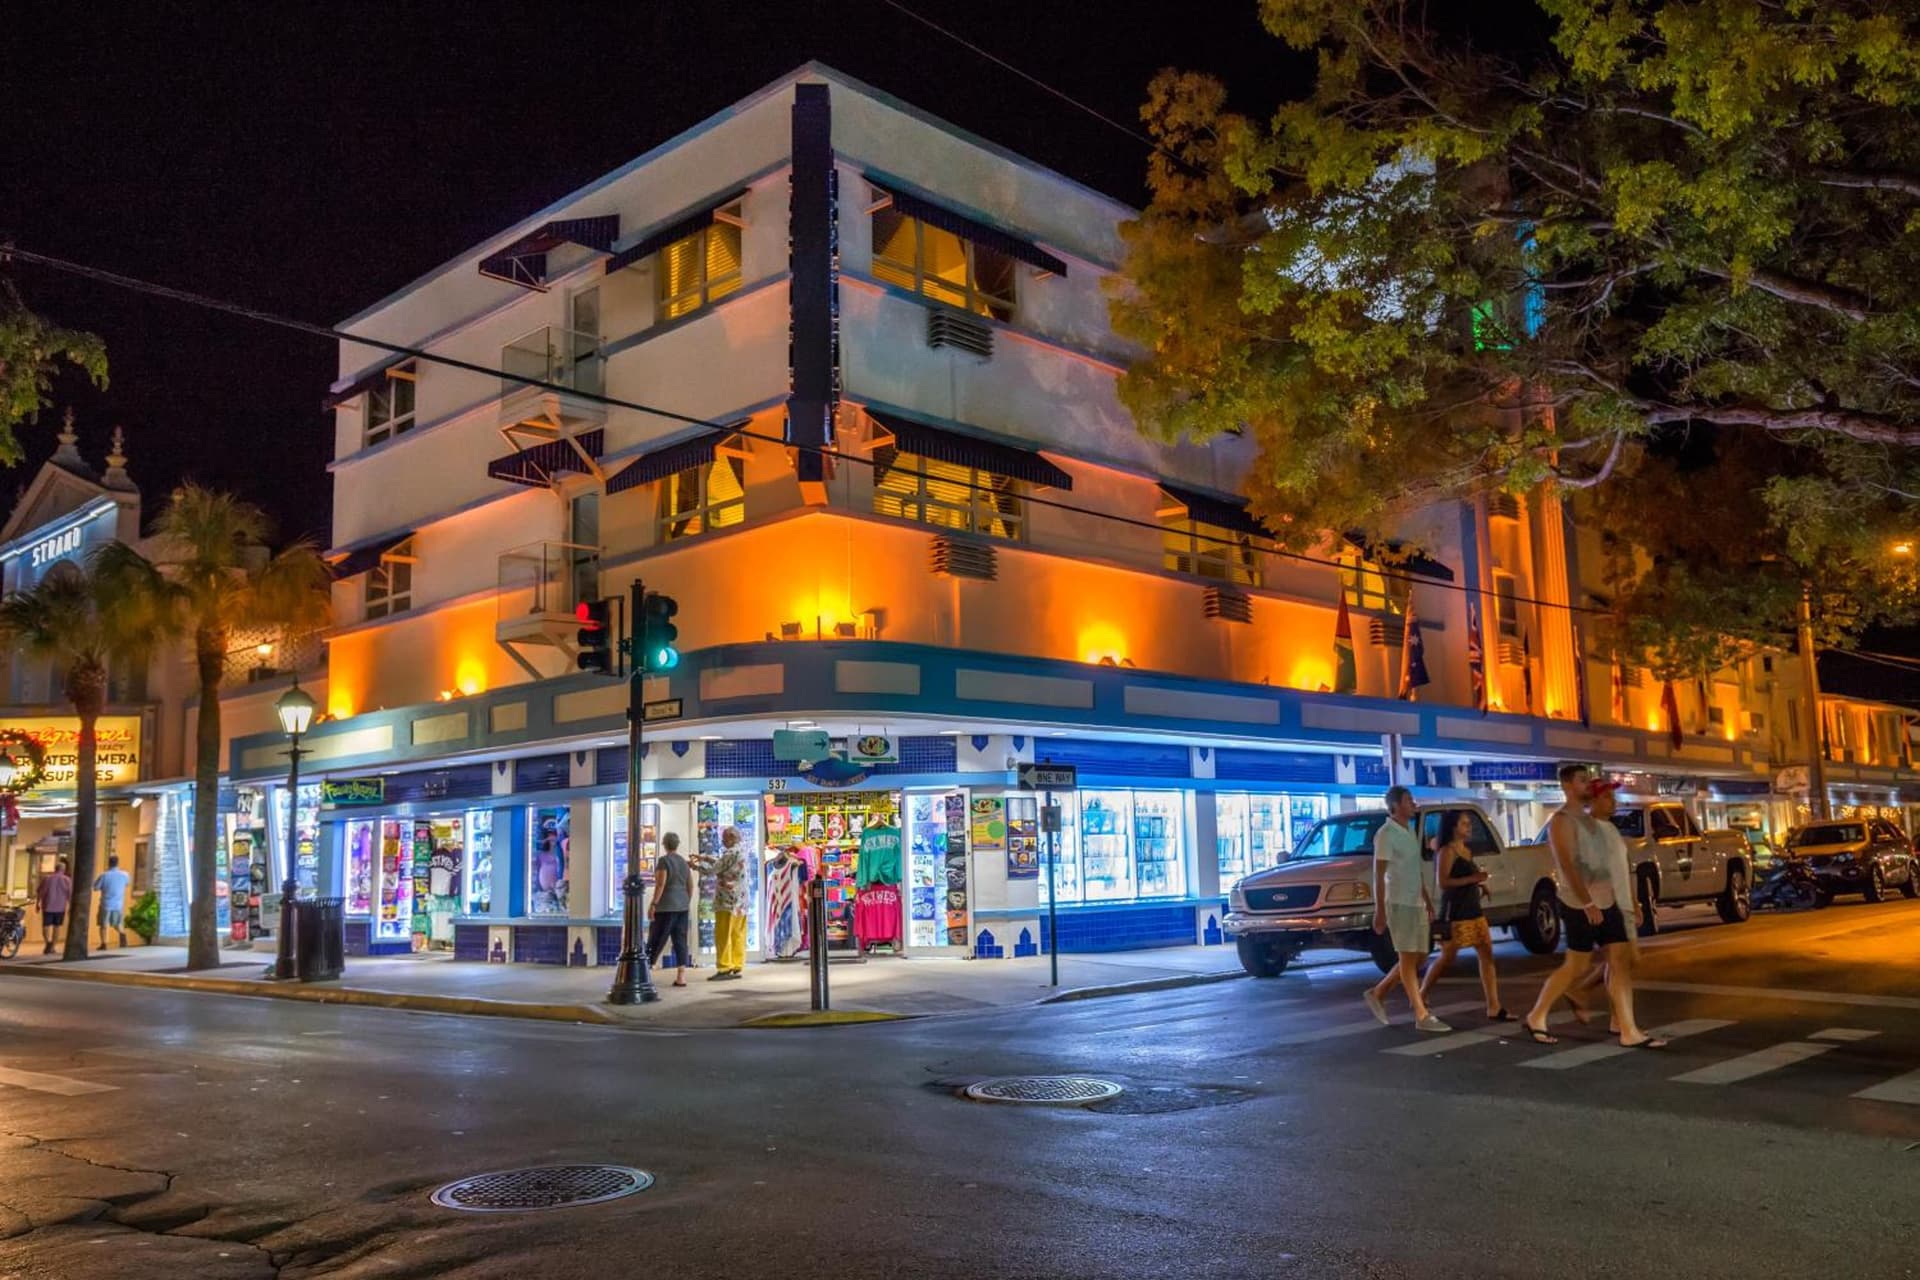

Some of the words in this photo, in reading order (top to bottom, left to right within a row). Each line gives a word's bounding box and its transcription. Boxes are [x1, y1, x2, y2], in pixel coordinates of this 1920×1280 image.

[31, 526, 81, 567] STRAND
[1037, 771, 1055, 784] ONE
[1056, 771, 1072, 784] WAY
[768, 779, 786, 790] 537
